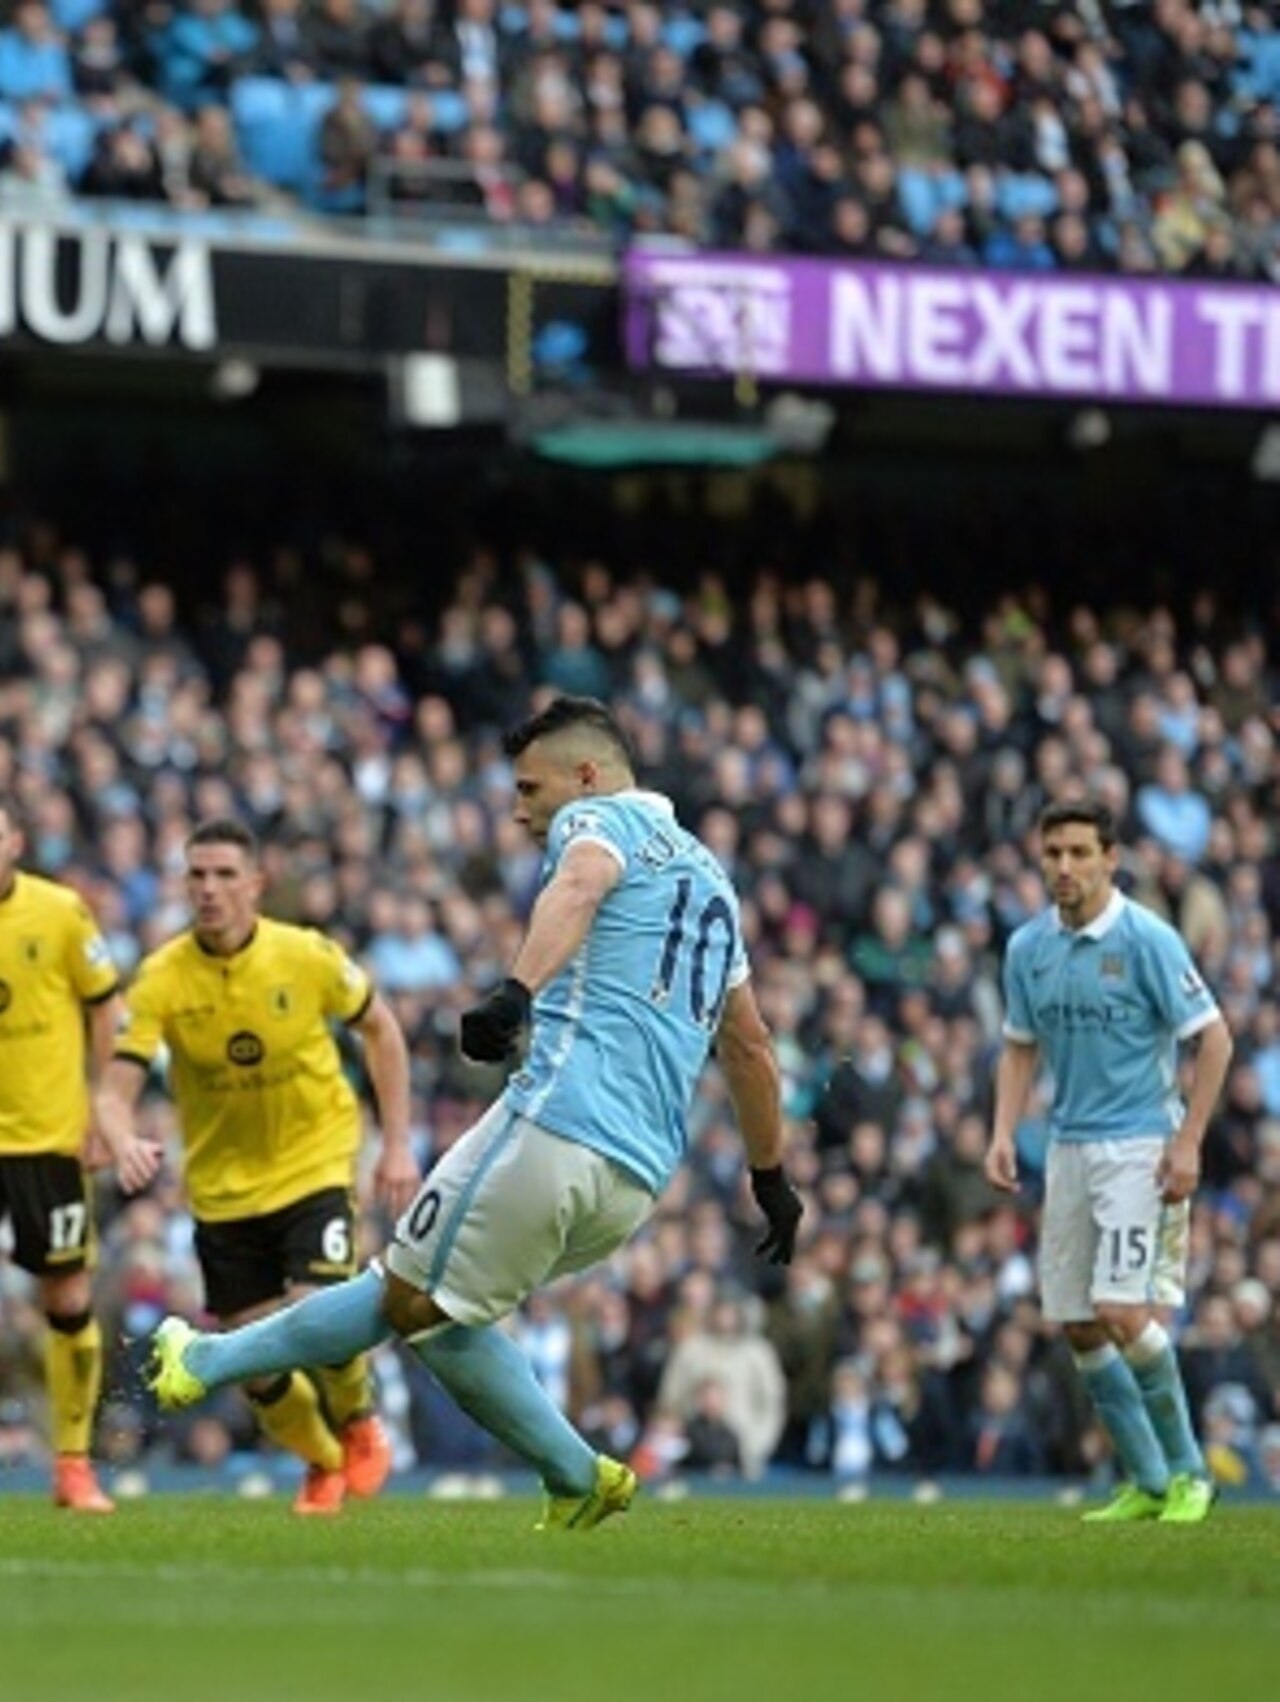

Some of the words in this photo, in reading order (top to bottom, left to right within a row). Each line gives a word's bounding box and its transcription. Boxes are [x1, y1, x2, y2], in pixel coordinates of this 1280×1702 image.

[827, 270, 1174, 396] NEXEN
[651, 877, 735, 1032] 10
[50, 1203, 86, 1249] 17
[322, 1217, 350, 1263] 6
[1110, 1226, 1147, 1269] 15
